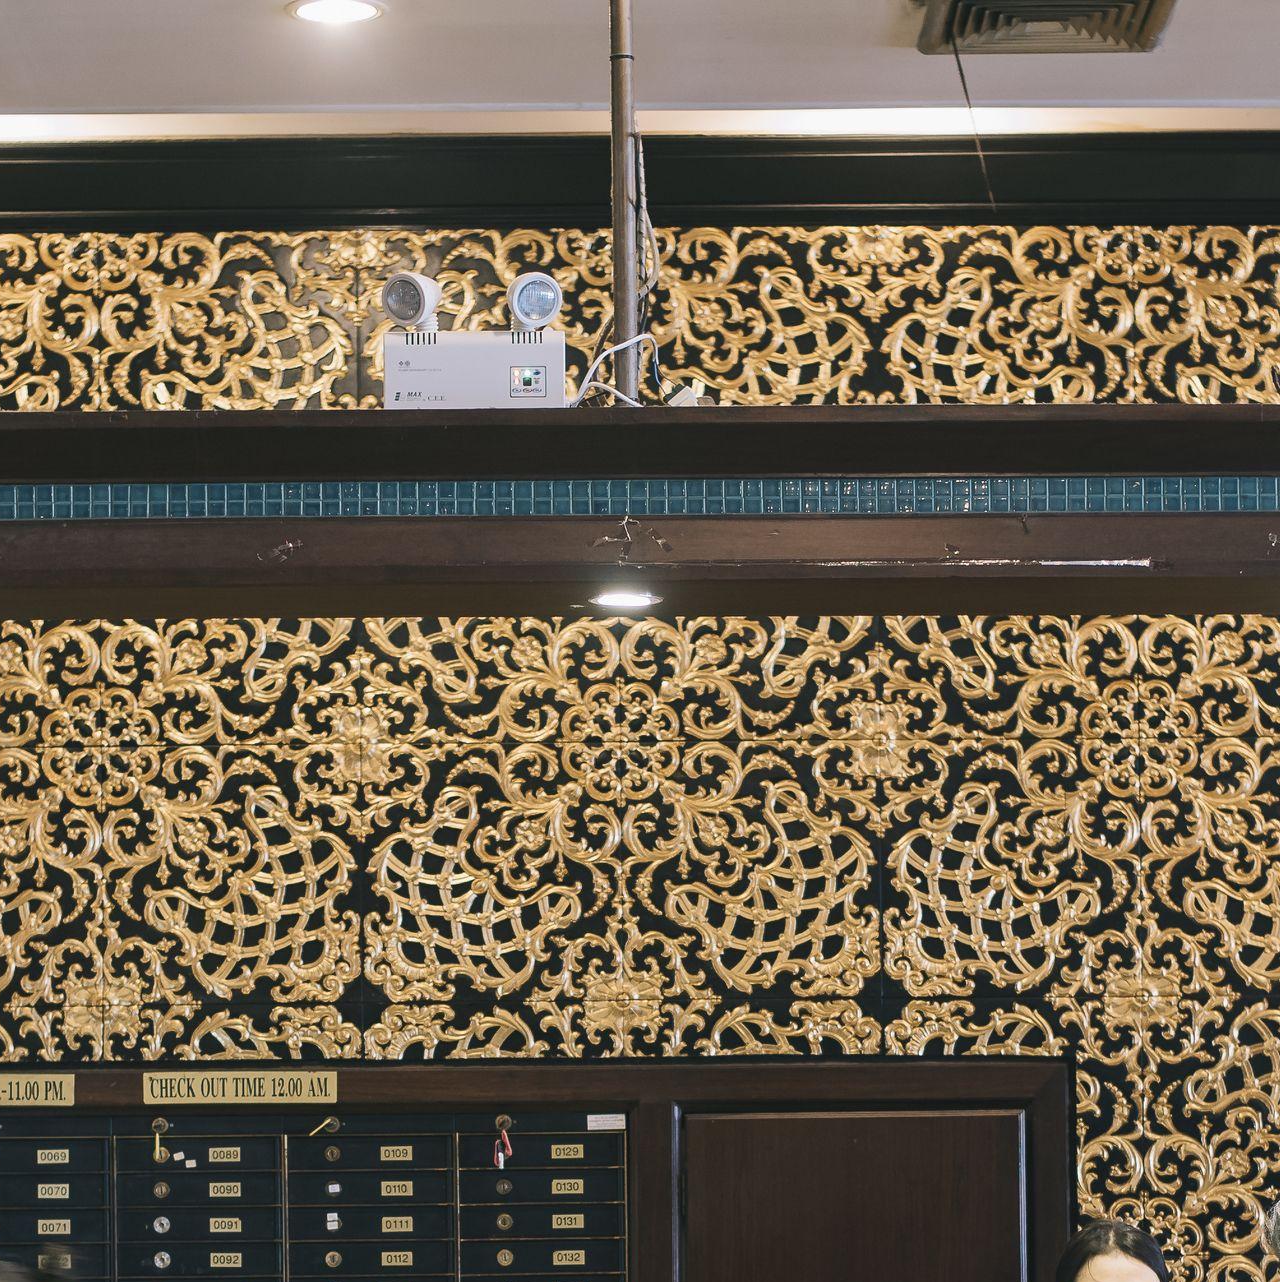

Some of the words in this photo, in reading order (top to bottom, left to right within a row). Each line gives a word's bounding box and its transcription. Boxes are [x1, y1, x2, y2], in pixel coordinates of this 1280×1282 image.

[44, 1080, 66, 1101] PM.
[150, 1077, 196, 1098] CHECK
[201, 1077, 228, 1098] OUT
[233, 1077, 266, 1097] TIME
[271, 1077, 302, 1097] 12.00
[307, 1077, 331, 1097] AM.
[40, 1152, 66, 1161] 0069
[212, 1150, 238, 1160] 0089
[384, 1148, 408, 1158] 0109
[555, 1147, 579, 1157] 0129
[40, 1186, 67, 1196] 0070
[212, 1184, 239, 1195] 0090
[385, 1184, 407, 1194] 0110
[556, 1182, 579, 1192] 0130
[214, 1220, 238, 1230] 0091
[385, 1220, 408, 1229] 0111
[556, 1216, 577, 1226] 0131
[42, 1223, 66, 1232] 0071
[212, 1255, 239, 1264] 0092
[386, 1254, 408, 1264] 0112
[557, 1252, 580, 1262] 0132
